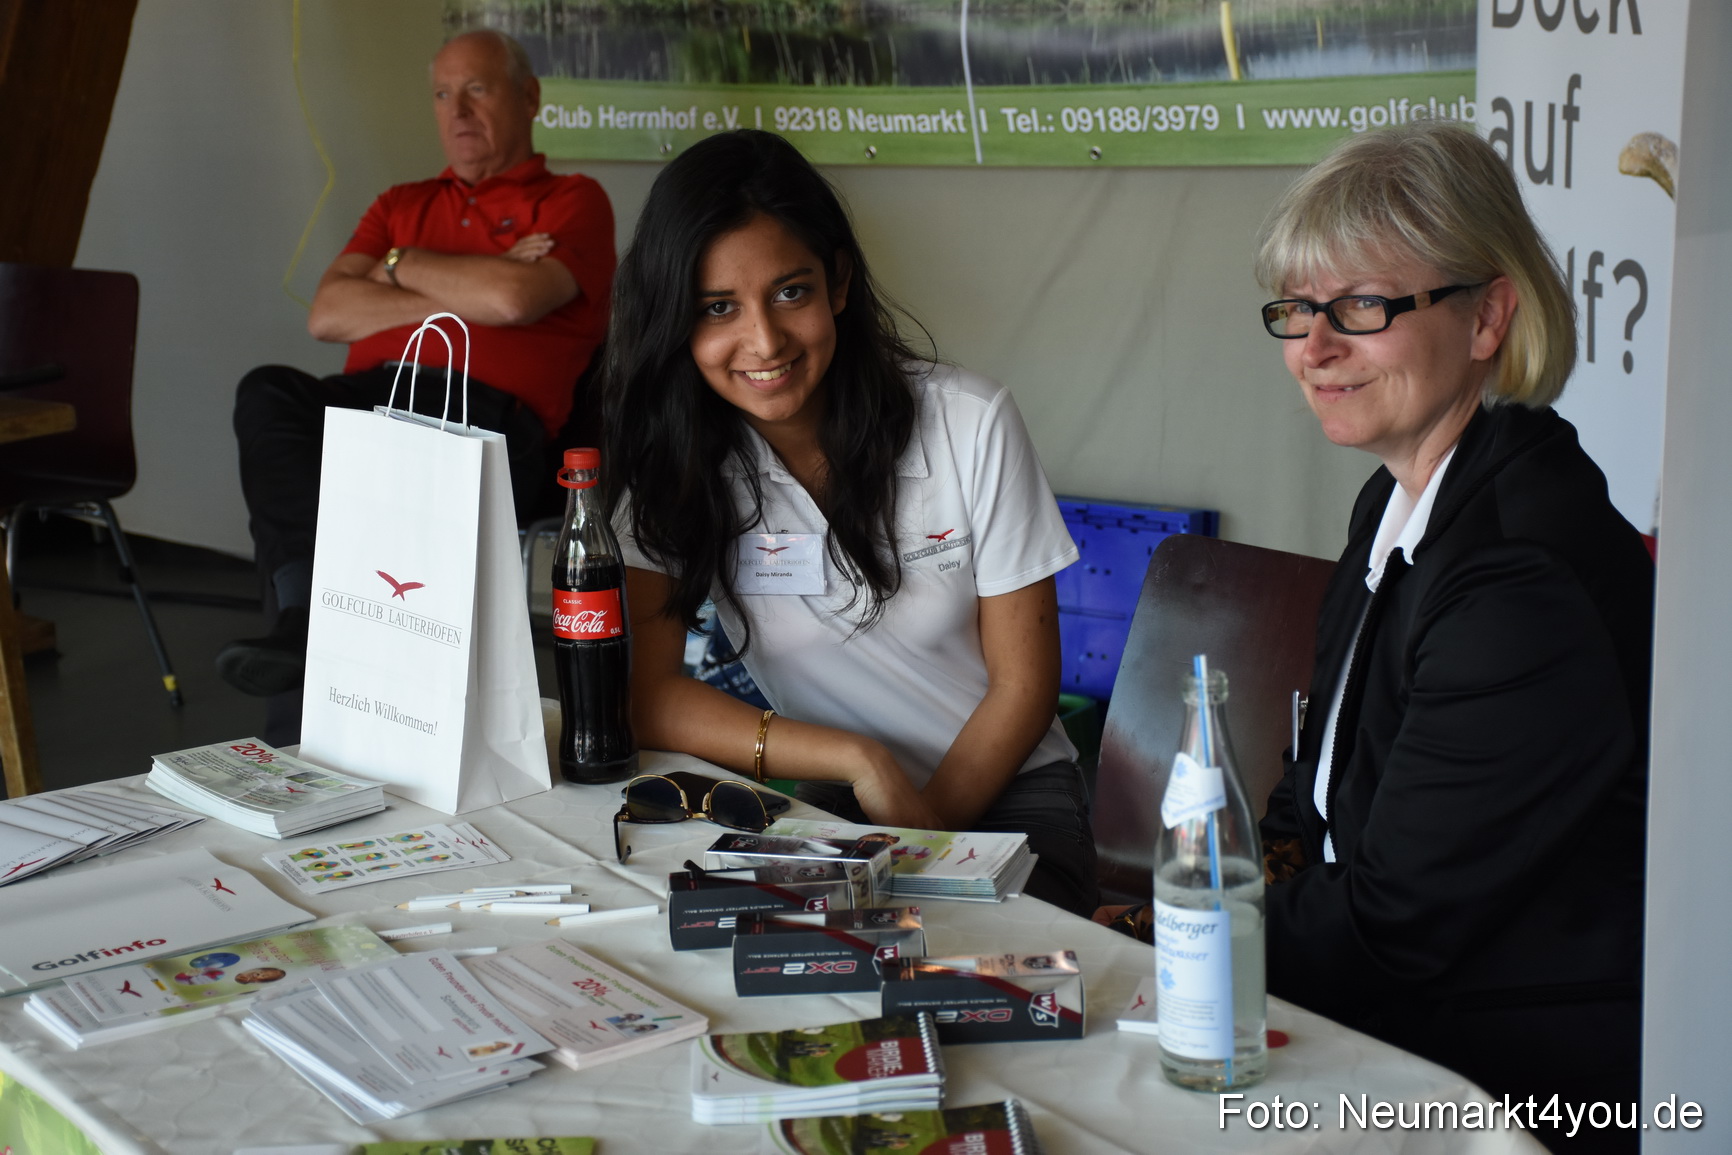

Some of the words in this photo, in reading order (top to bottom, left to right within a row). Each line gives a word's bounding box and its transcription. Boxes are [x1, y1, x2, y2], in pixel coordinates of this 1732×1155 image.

[598, 105, 699, 131] Herrnhof
[703, 107, 741, 131] e.V.
[775, 107, 843, 132] 92318
[849, 107, 966, 134] Neumarkt
[1001, 106, 1055, 133] Tel.:
[1061, 105, 1220, 134] 09188/3979
[1488, 73, 1582, 189] auf
[938, 560, 961, 572] Daisy
[322, 591, 383, 620] GOLFCLUB
[388, 612, 462, 645] LAUTERHOFEN
[329, 686, 371, 713] Herzlich
[374, 700, 438, 736] Willkommen!
[230, 743, 279, 764] 20%
[31, 938, 167, 971] Golfinfo
[782, 960, 858, 975] DX2
[429, 957, 446, 972] Guten
[445, 971, 467, 994] Freunden
[475, 1003, 494, 1019] Freude
[571, 978, 612, 997] 20%
[935, 1008, 1013, 1023] DX2
